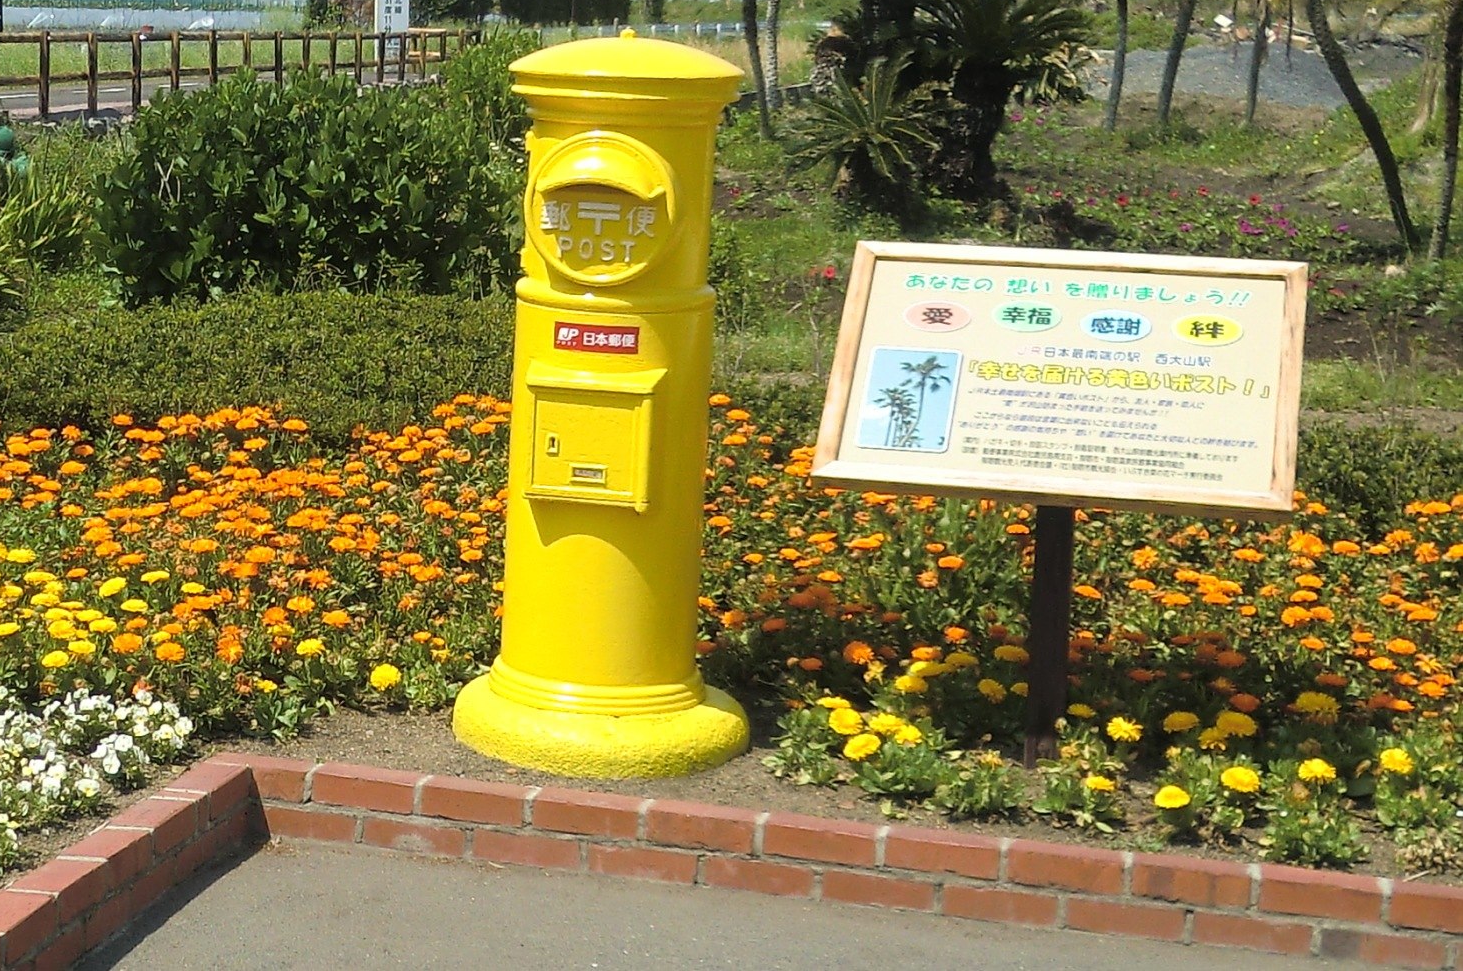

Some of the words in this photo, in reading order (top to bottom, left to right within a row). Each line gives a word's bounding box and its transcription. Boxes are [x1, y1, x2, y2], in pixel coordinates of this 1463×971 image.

[558, 236, 636, 263] POST
[905, 274, 994, 291] あなたの
[1007, 279, 1051, 293] 想い
[921, 307, 954, 326] 愛
[1002, 307, 1053, 326] 幸福
[1090, 316, 1143, 336] 感謝
[1189, 320, 1225, 339] 絆
[582, 331, 636, 348] 日本郵便
[1154, 353, 1212, 367] 西大山駅
